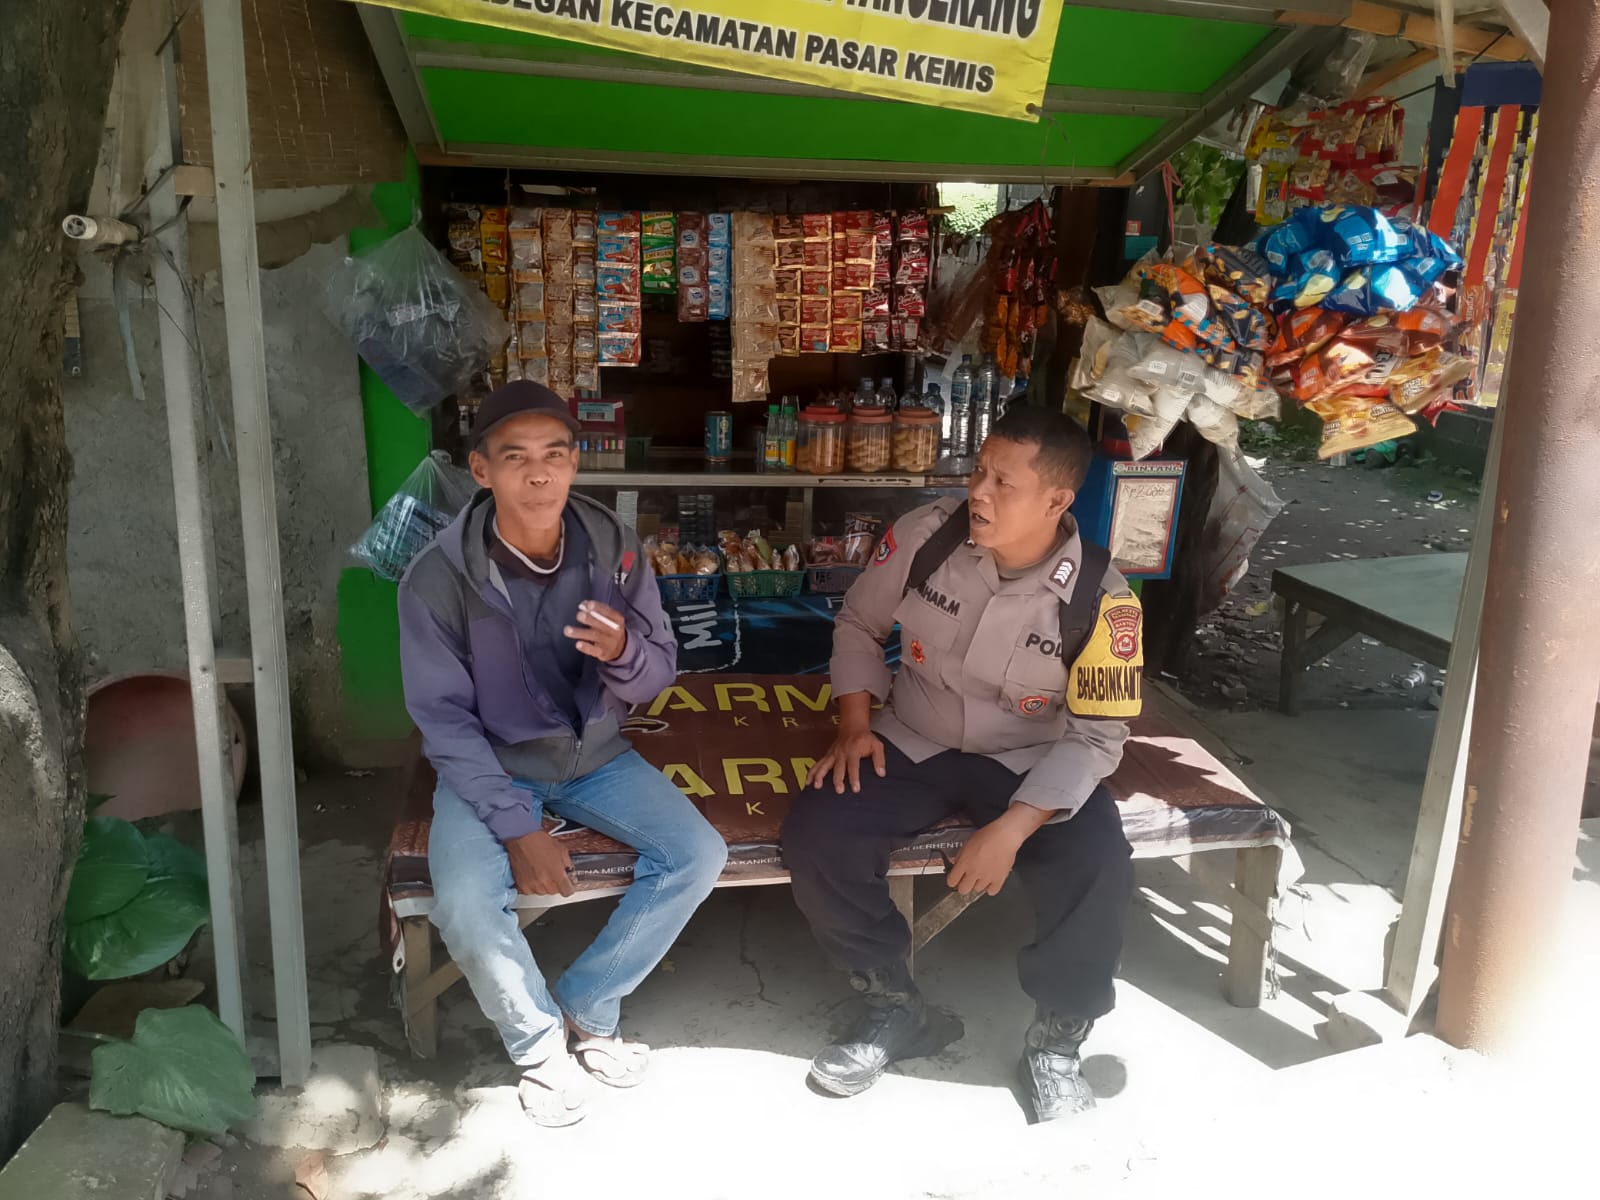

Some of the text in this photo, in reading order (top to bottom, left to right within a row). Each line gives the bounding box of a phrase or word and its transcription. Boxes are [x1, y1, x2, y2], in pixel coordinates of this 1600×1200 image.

[611, 0, 797, 58] KECAMATAN
[804, 35, 898, 76] PASAR
[905, 53, 994, 93] KEMIS
[739, 856, 781, 865] KANKER
